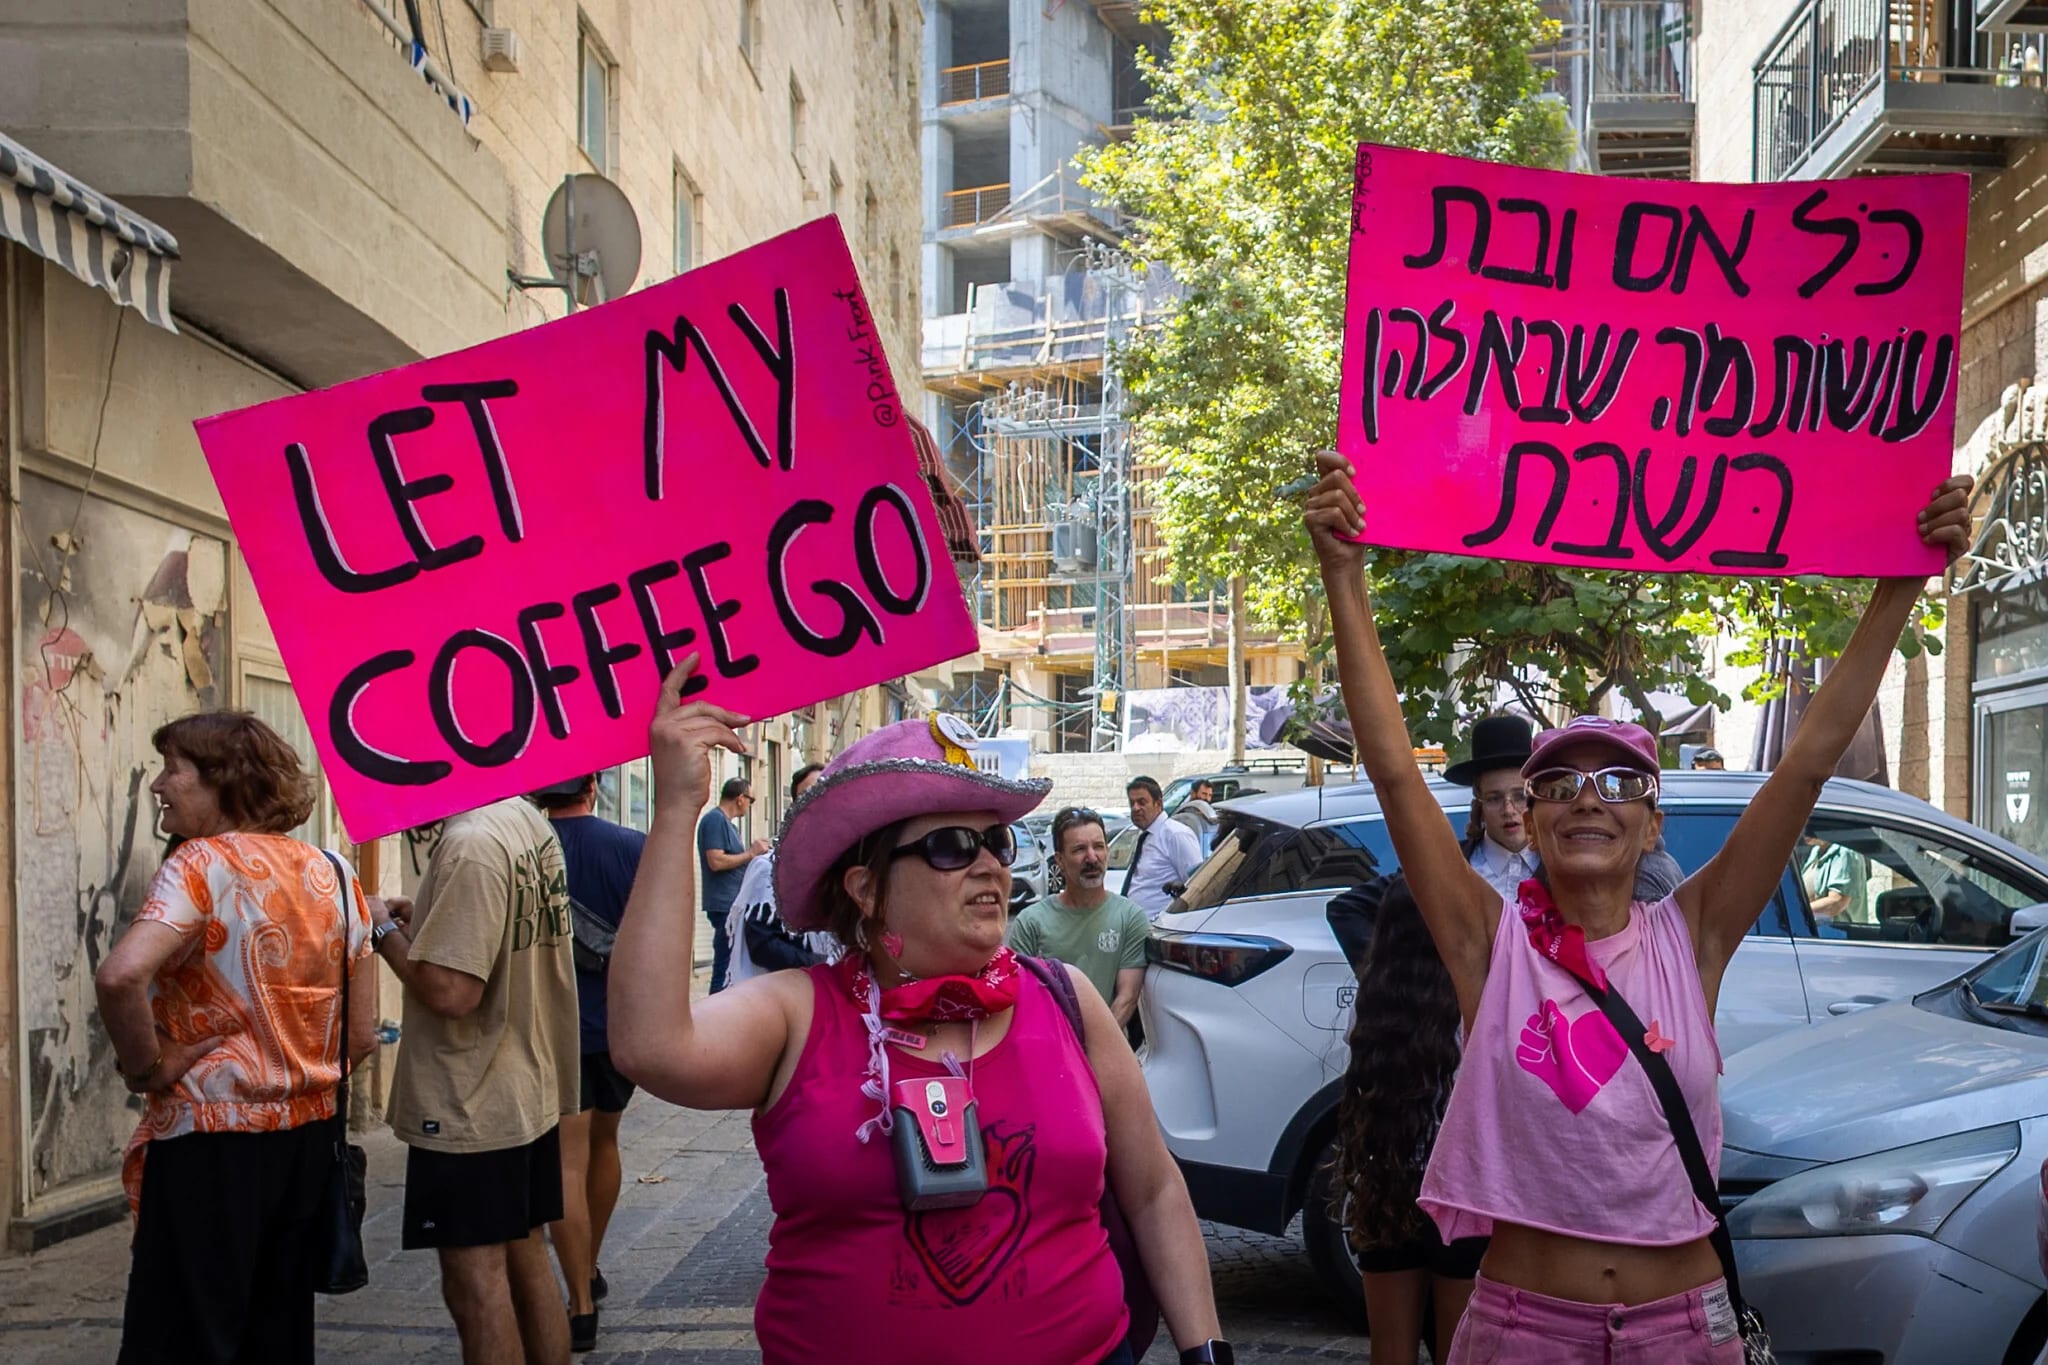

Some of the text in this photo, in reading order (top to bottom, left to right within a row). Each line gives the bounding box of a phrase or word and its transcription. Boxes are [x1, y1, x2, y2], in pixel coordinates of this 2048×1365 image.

[1403, 185, 1578, 293] ובת
[1613, 201, 1757, 299] אם
[1651, 322, 1758, 438] מה
[284, 287, 797, 594] LET MY
[328, 483, 933, 786] COFFEE GO
